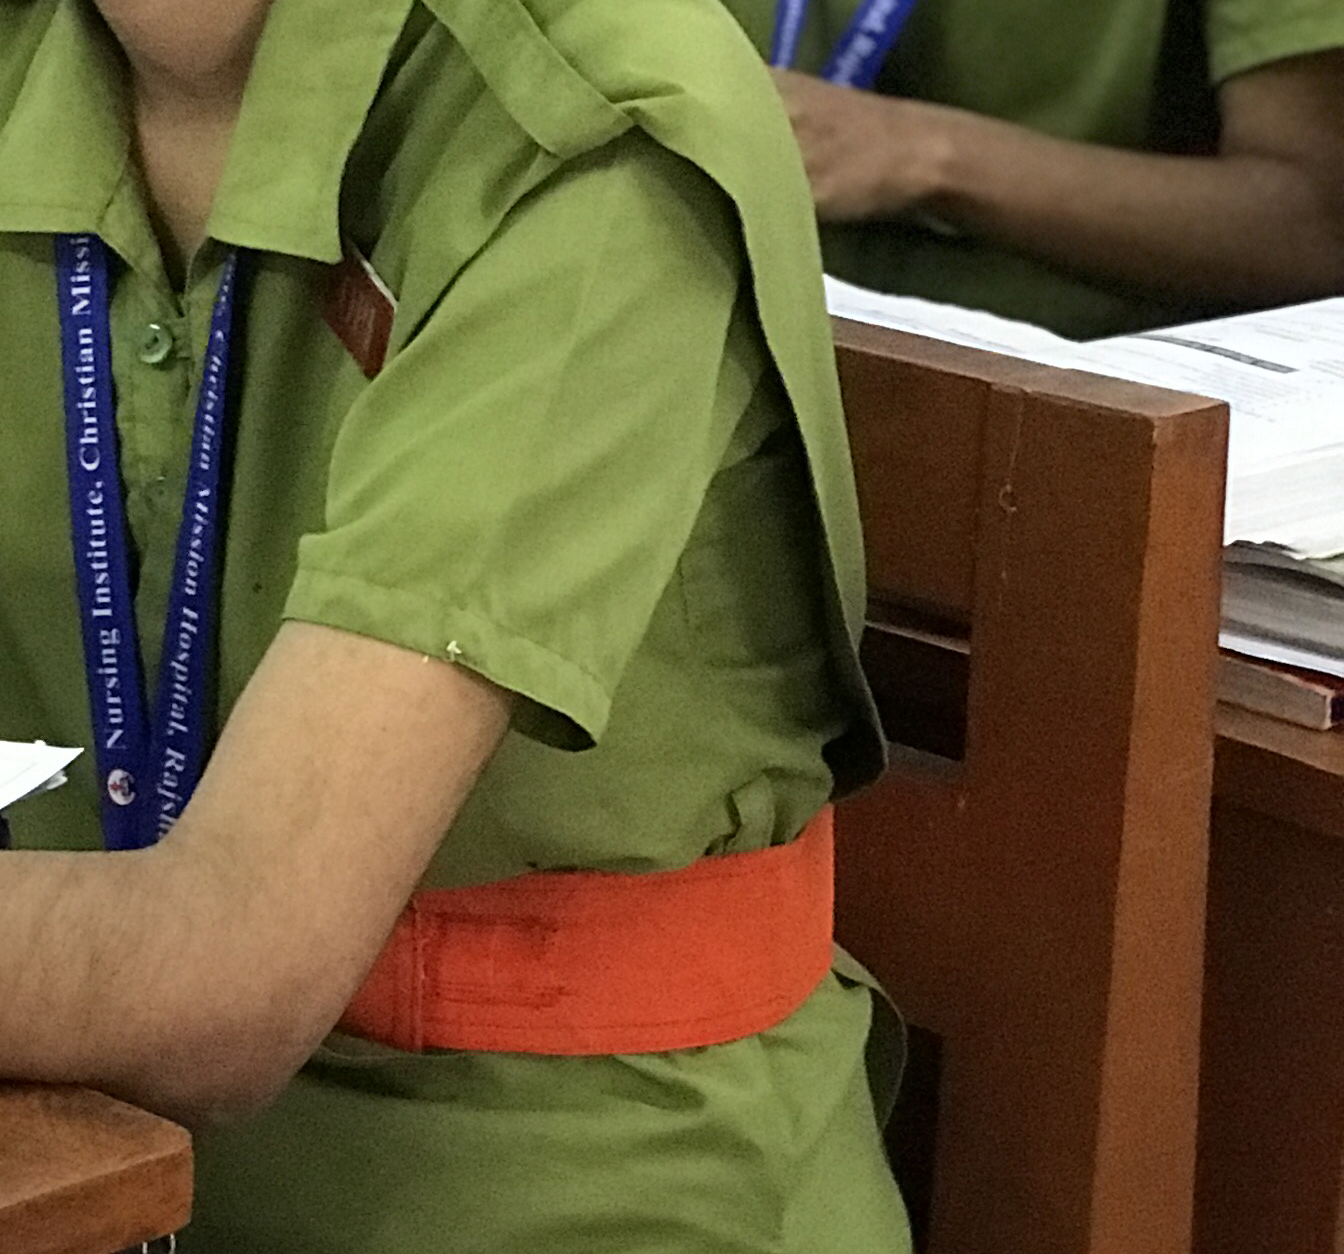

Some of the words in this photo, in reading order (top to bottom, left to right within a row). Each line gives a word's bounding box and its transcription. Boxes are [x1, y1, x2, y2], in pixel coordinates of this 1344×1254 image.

[75, 327, 101, 471] Christian
[85, 480, 113, 617] Institute,
[184, 484, 211, 596] Mission
[97, 627, 127, 750] Nursing
